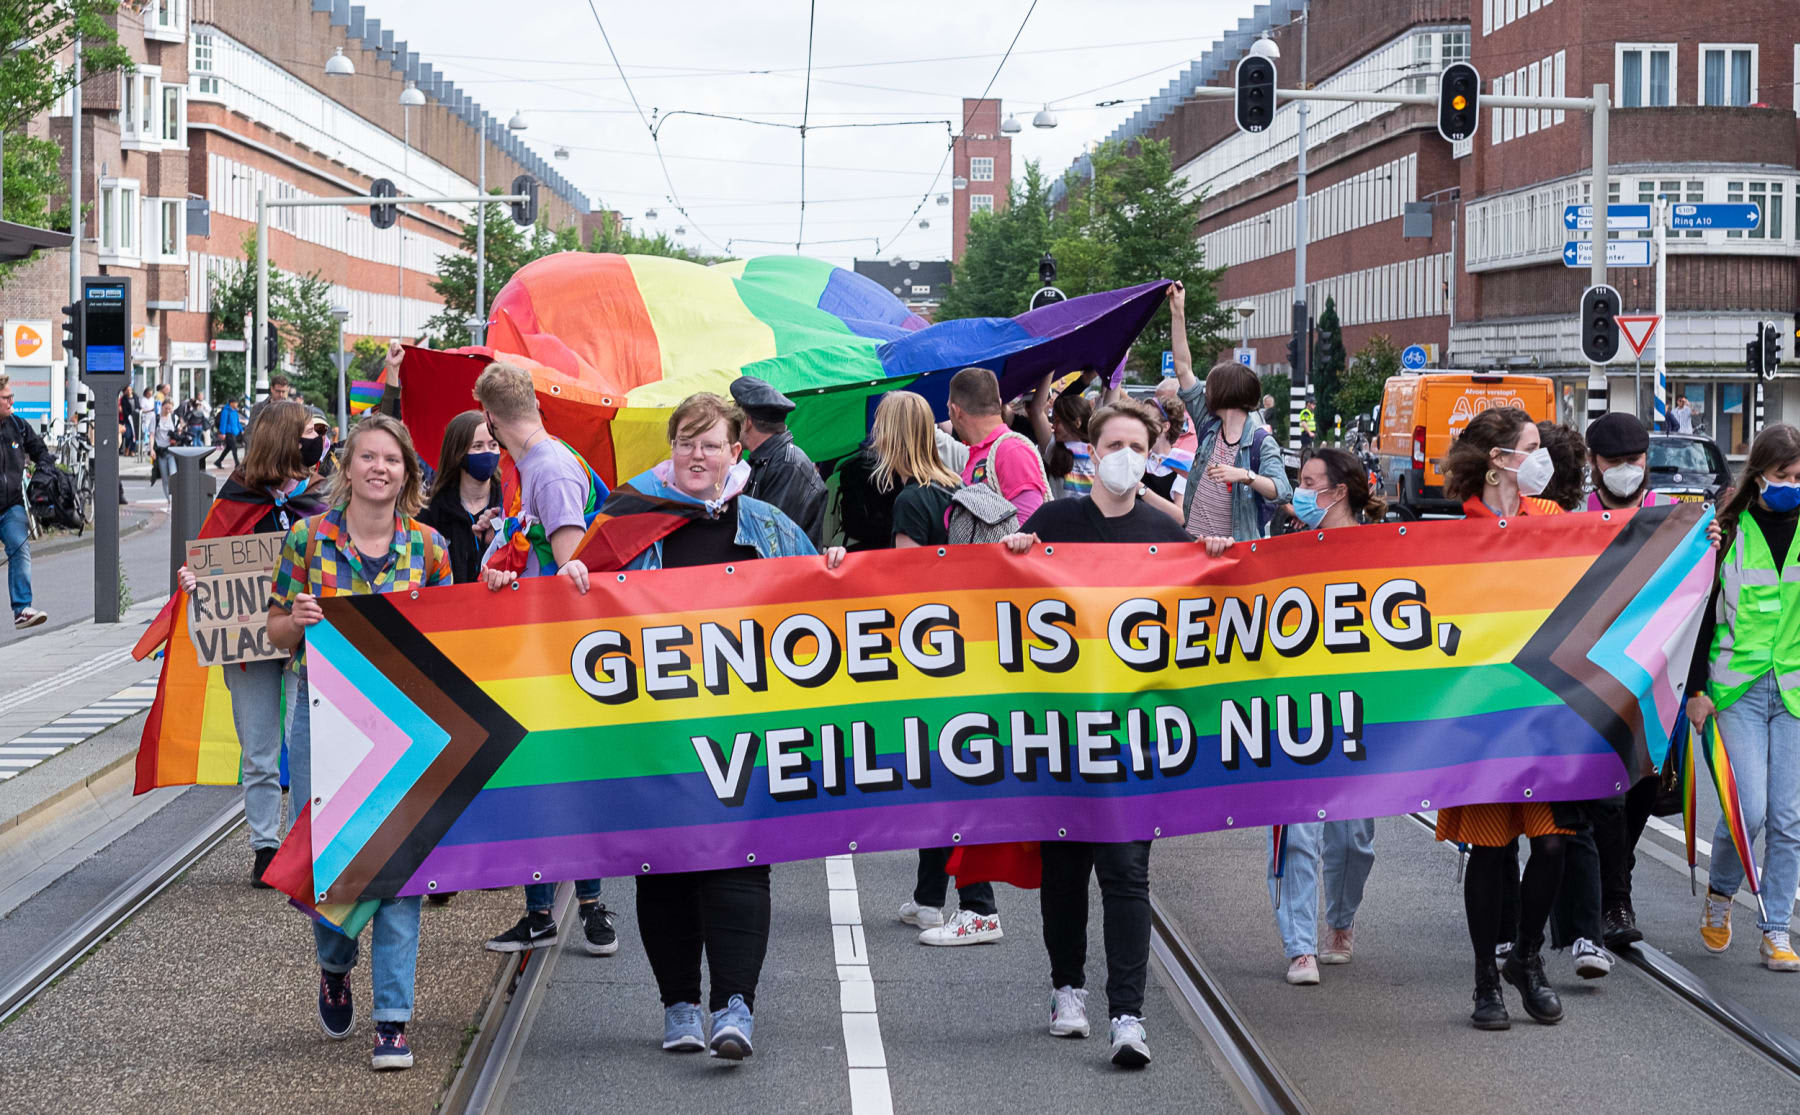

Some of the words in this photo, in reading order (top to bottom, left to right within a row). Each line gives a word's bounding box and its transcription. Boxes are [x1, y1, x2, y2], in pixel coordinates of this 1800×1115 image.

[1674, 217, 1694, 227] Ring
[1696, 217, 1712, 225] A10
[191, 543, 222, 570] JE
[195, 626, 289, 662] VLAG
[571, 603, 966, 705] GENOEG
[996, 599, 1079, 673] IS
[1107, 578, 1462, 673] GENOEG,
[690, 704, 1198, 807] VEILIGHEID
[1220, 691, 1367, 770] NU!
